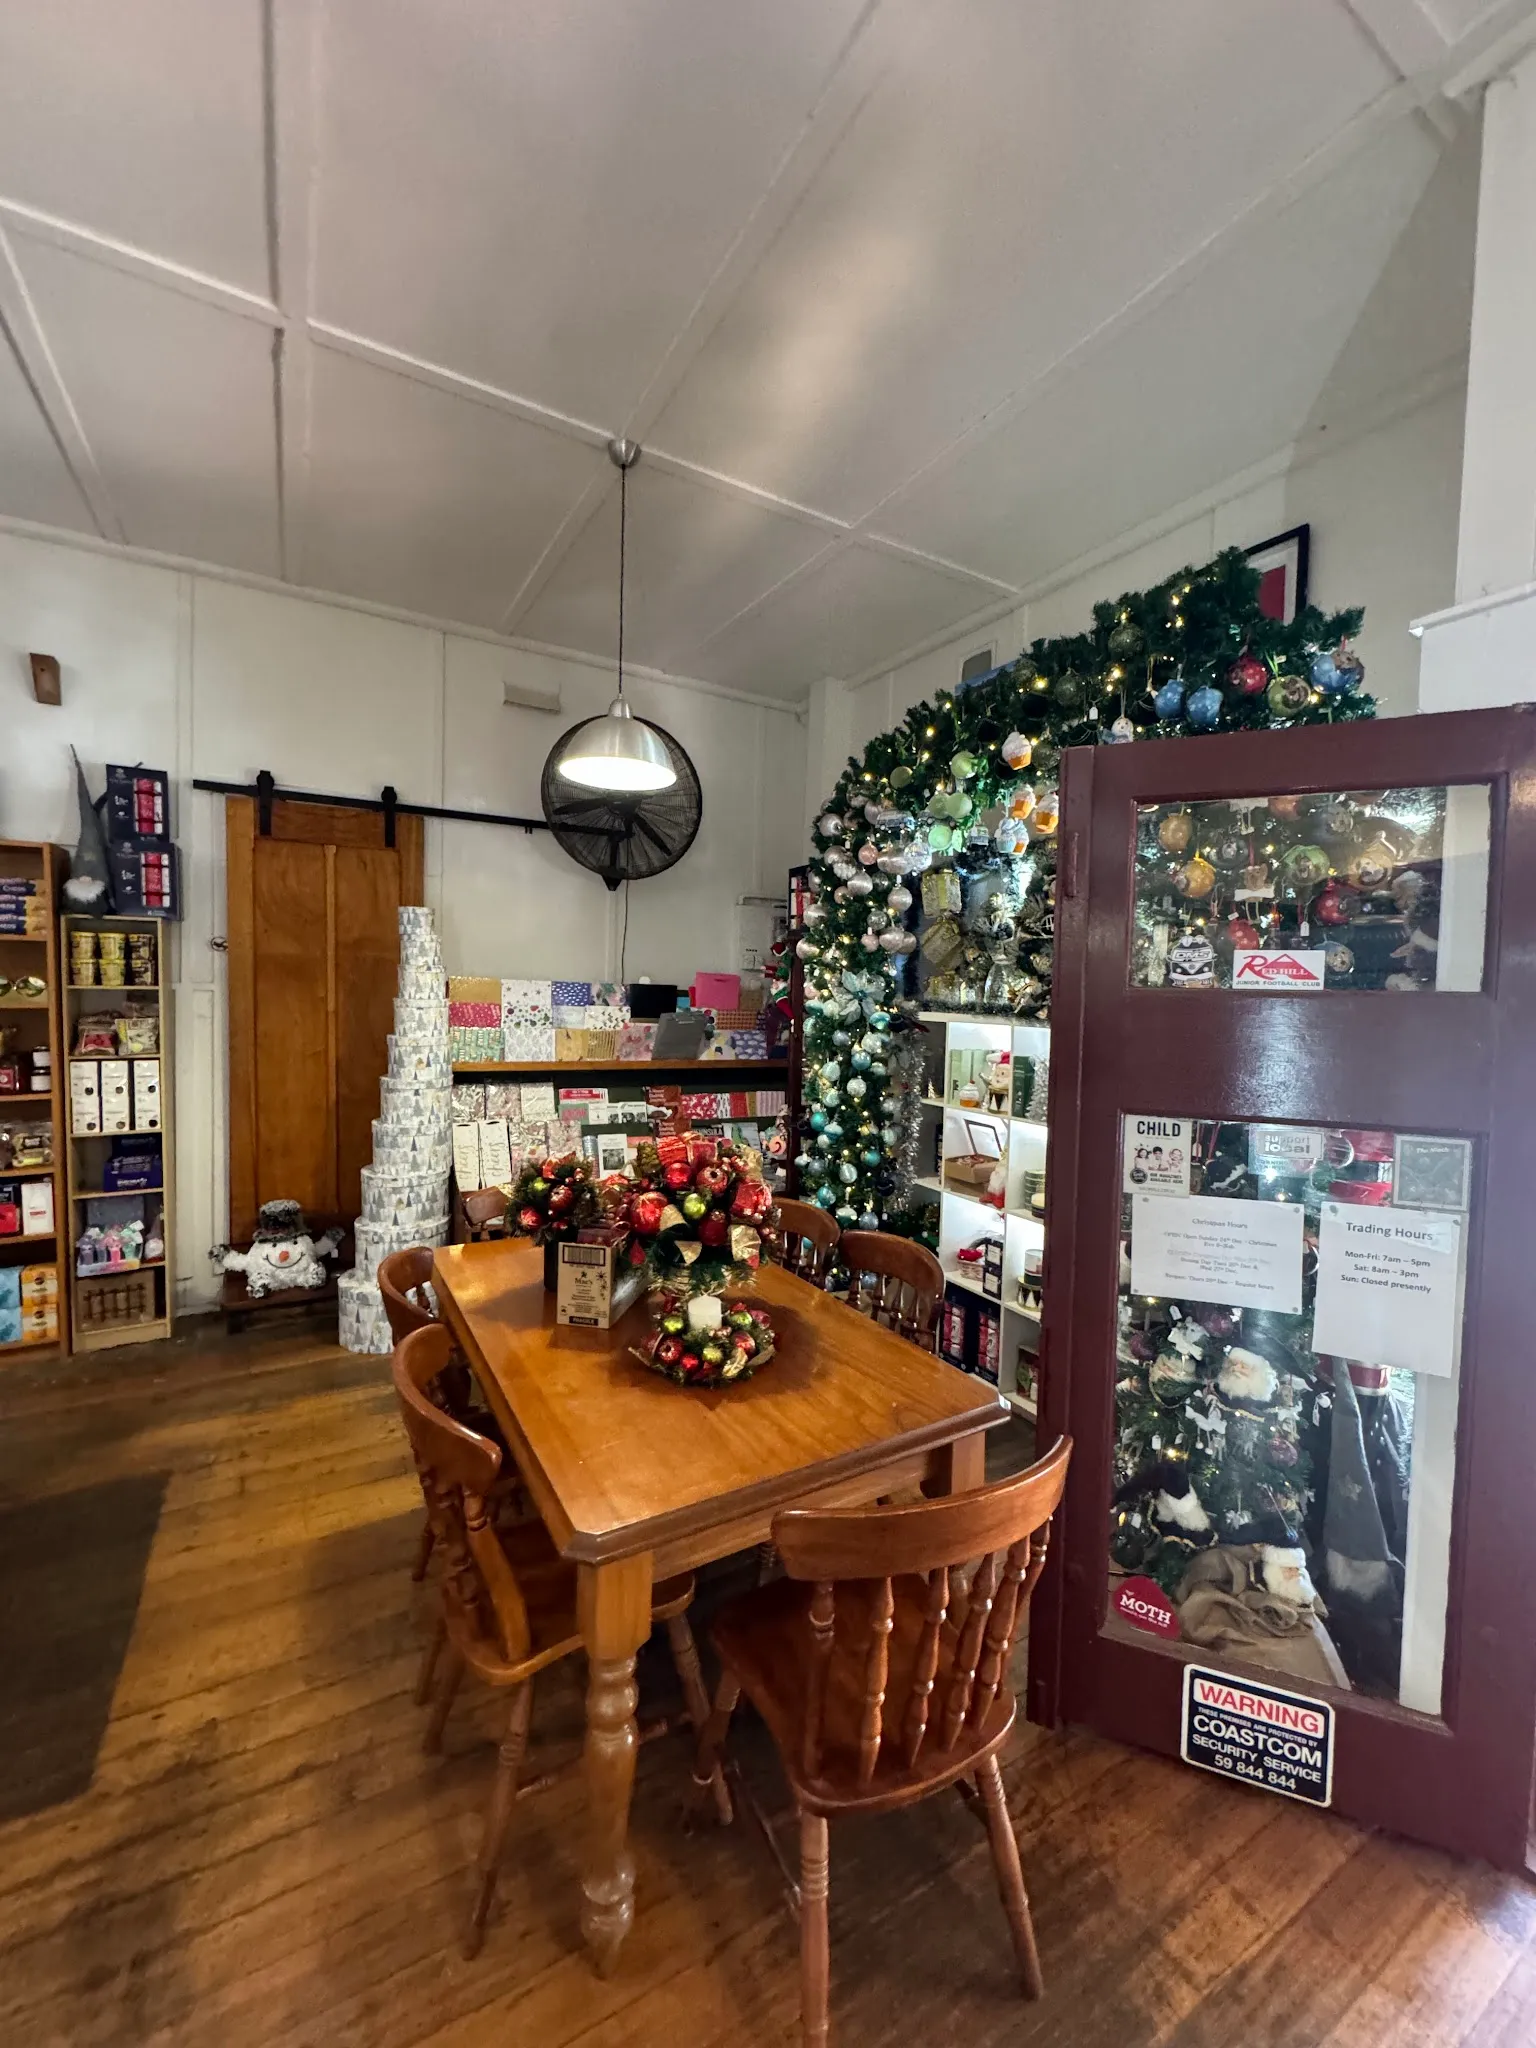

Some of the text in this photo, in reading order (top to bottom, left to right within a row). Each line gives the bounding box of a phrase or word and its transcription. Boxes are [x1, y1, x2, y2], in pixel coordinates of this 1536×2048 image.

[1175, 951, 1210, 959] DMS
[1279, 968, 1308, 976] HILL
[1137, 1120, 1181, 1138] CHILD
[1265, 1142, 1310, 1153] local
[1227, 1221, 1248, 1229] Hours
[1346, 1222, 1433, 1241] Trading Hours
[1345, 1250, 1381, 1261] Mon-Fri:
[1383, 1254, 1401, 1264] 7am
[1411, 1258, 1430, 1267] 5pm
[1354, 1263, 1369, 1272] Sat:
[1371, 1266, 1390, 1275] 8am
[1399, 1269, 1419, 1278] 3pm
[1341, 1274, 1432, 1294] Sun: Closed presently
[1120, 1594, 1171, 1624] MOTH
[1200, 1682, 1319, 1734] WARNING
[1198, 1706, 1318, 1748] THESE PREMISES ARE PROTECTED BY
[1193, 1715, 1322, 1768] COASTCOM
[1192, 1733, 1322, 1783] SECURITY SERVICE
[1214, 1754, 1296, 1790] 59 844 844
